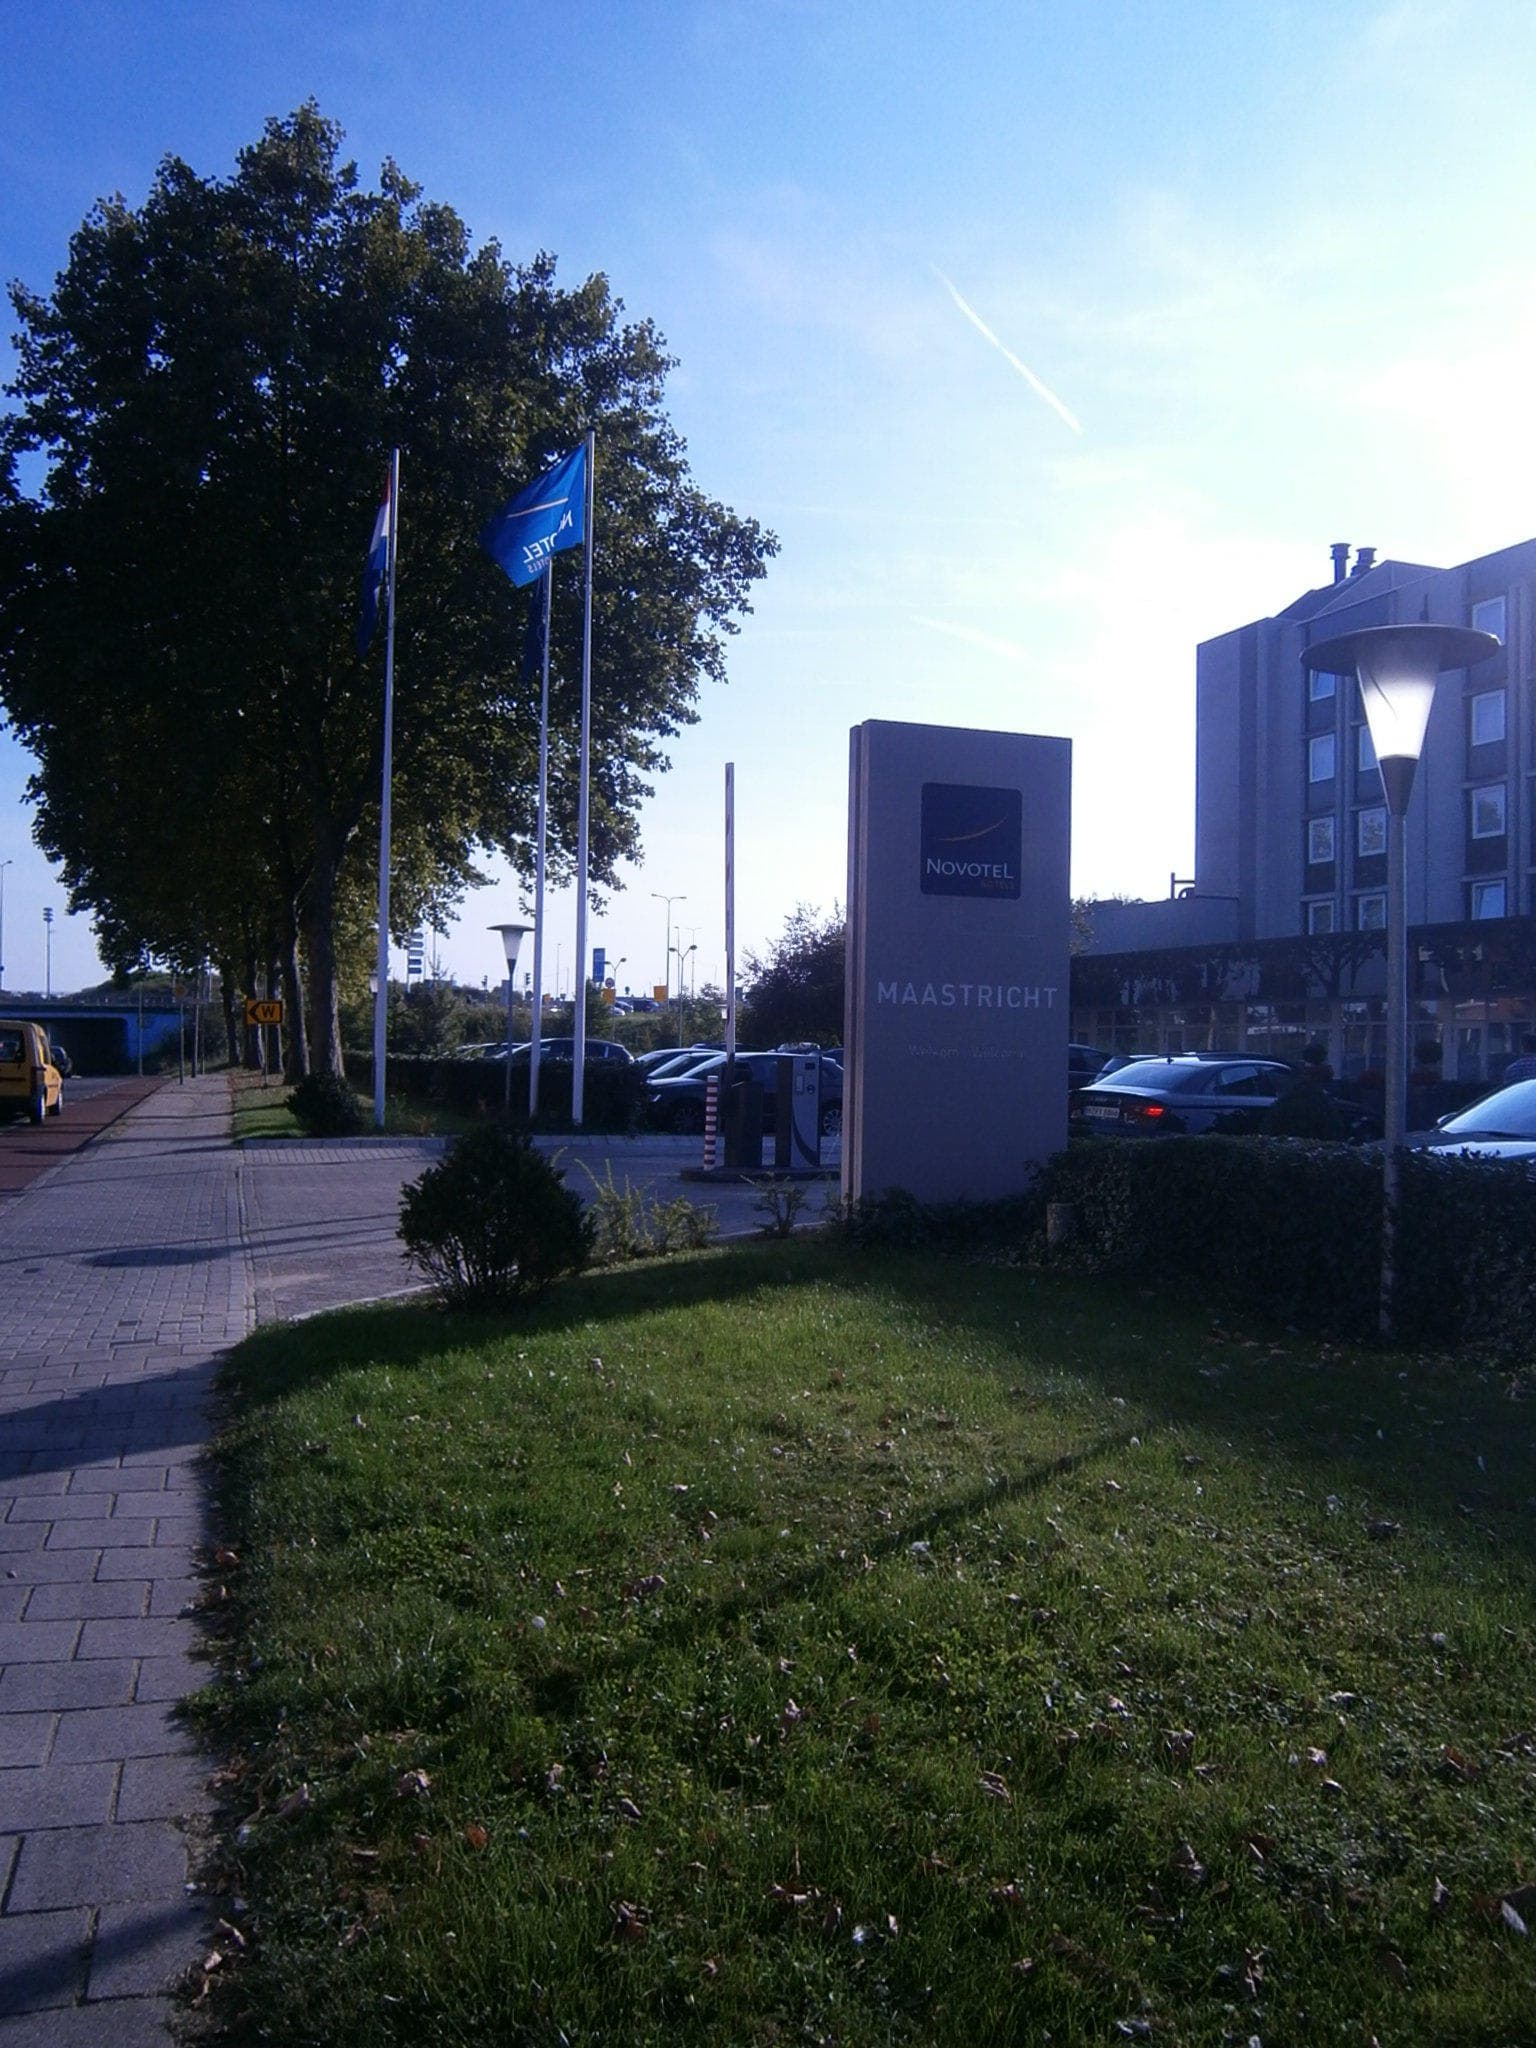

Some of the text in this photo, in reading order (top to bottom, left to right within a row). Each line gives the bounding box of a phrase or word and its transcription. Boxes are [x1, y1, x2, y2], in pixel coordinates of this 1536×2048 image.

[926, 858, 1014, 879] NOVOTEL
[877, 981, 1058, 1009] MAASTRICHT
[261, 1005, 276, 1018] W
